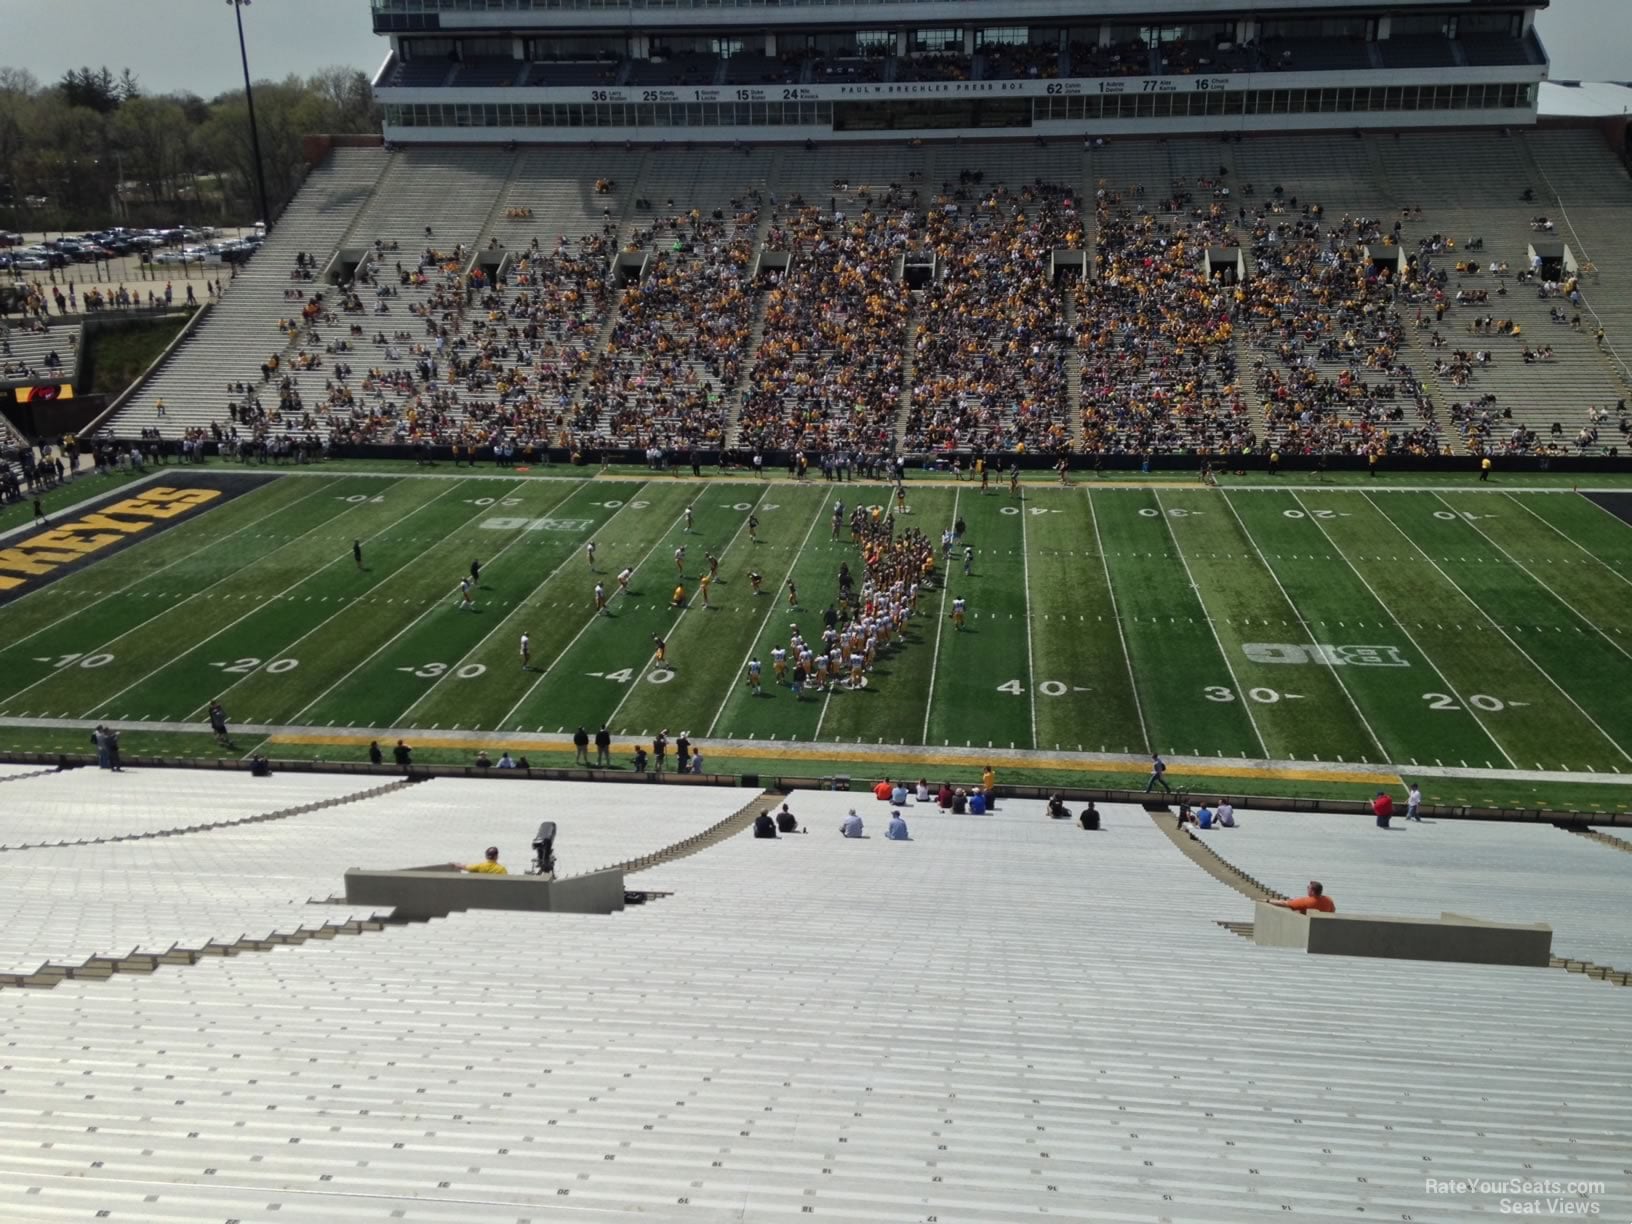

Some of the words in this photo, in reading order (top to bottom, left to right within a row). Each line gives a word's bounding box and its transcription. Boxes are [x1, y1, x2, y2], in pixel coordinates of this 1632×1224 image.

[888, 84, 948, 92] BRECHLER
[957, 83, 992, 91] PRESS
[1047, 83, 1063, 94] 62
[1098, 82, 1104, 92] 1
[1143, 80, 1157, 91] 77
[1195, 79, 1209, 90] 16
[592, 90, 607, 101] 36
[643, 91, 658, 101] 25
[694, 90, 700, 101] 1
[736, 90, 749, 101] 15
[783, 89, 798, 100] 24
[602, 500, 650, 509] 30
[731, 502, 778, 510] 40
[998, 507, 1046, 515] 40
[1283, 510, 1335, 518] 20
[50, 653, 115, 668] 10
[222, 658, 299, 673] 20
[415, 662, 487, 678] 30
[605, 668, 675, 684] 40
[997, 679, 1068, 696] 40
[1203, 686, 1280, 703] 30
[1421, 693, 1505, 711] 20
[556, 1188, 570, 1196] 20
[677, 1197, 689, 1205] 19
[927, 1215, 937, 1223] 17
